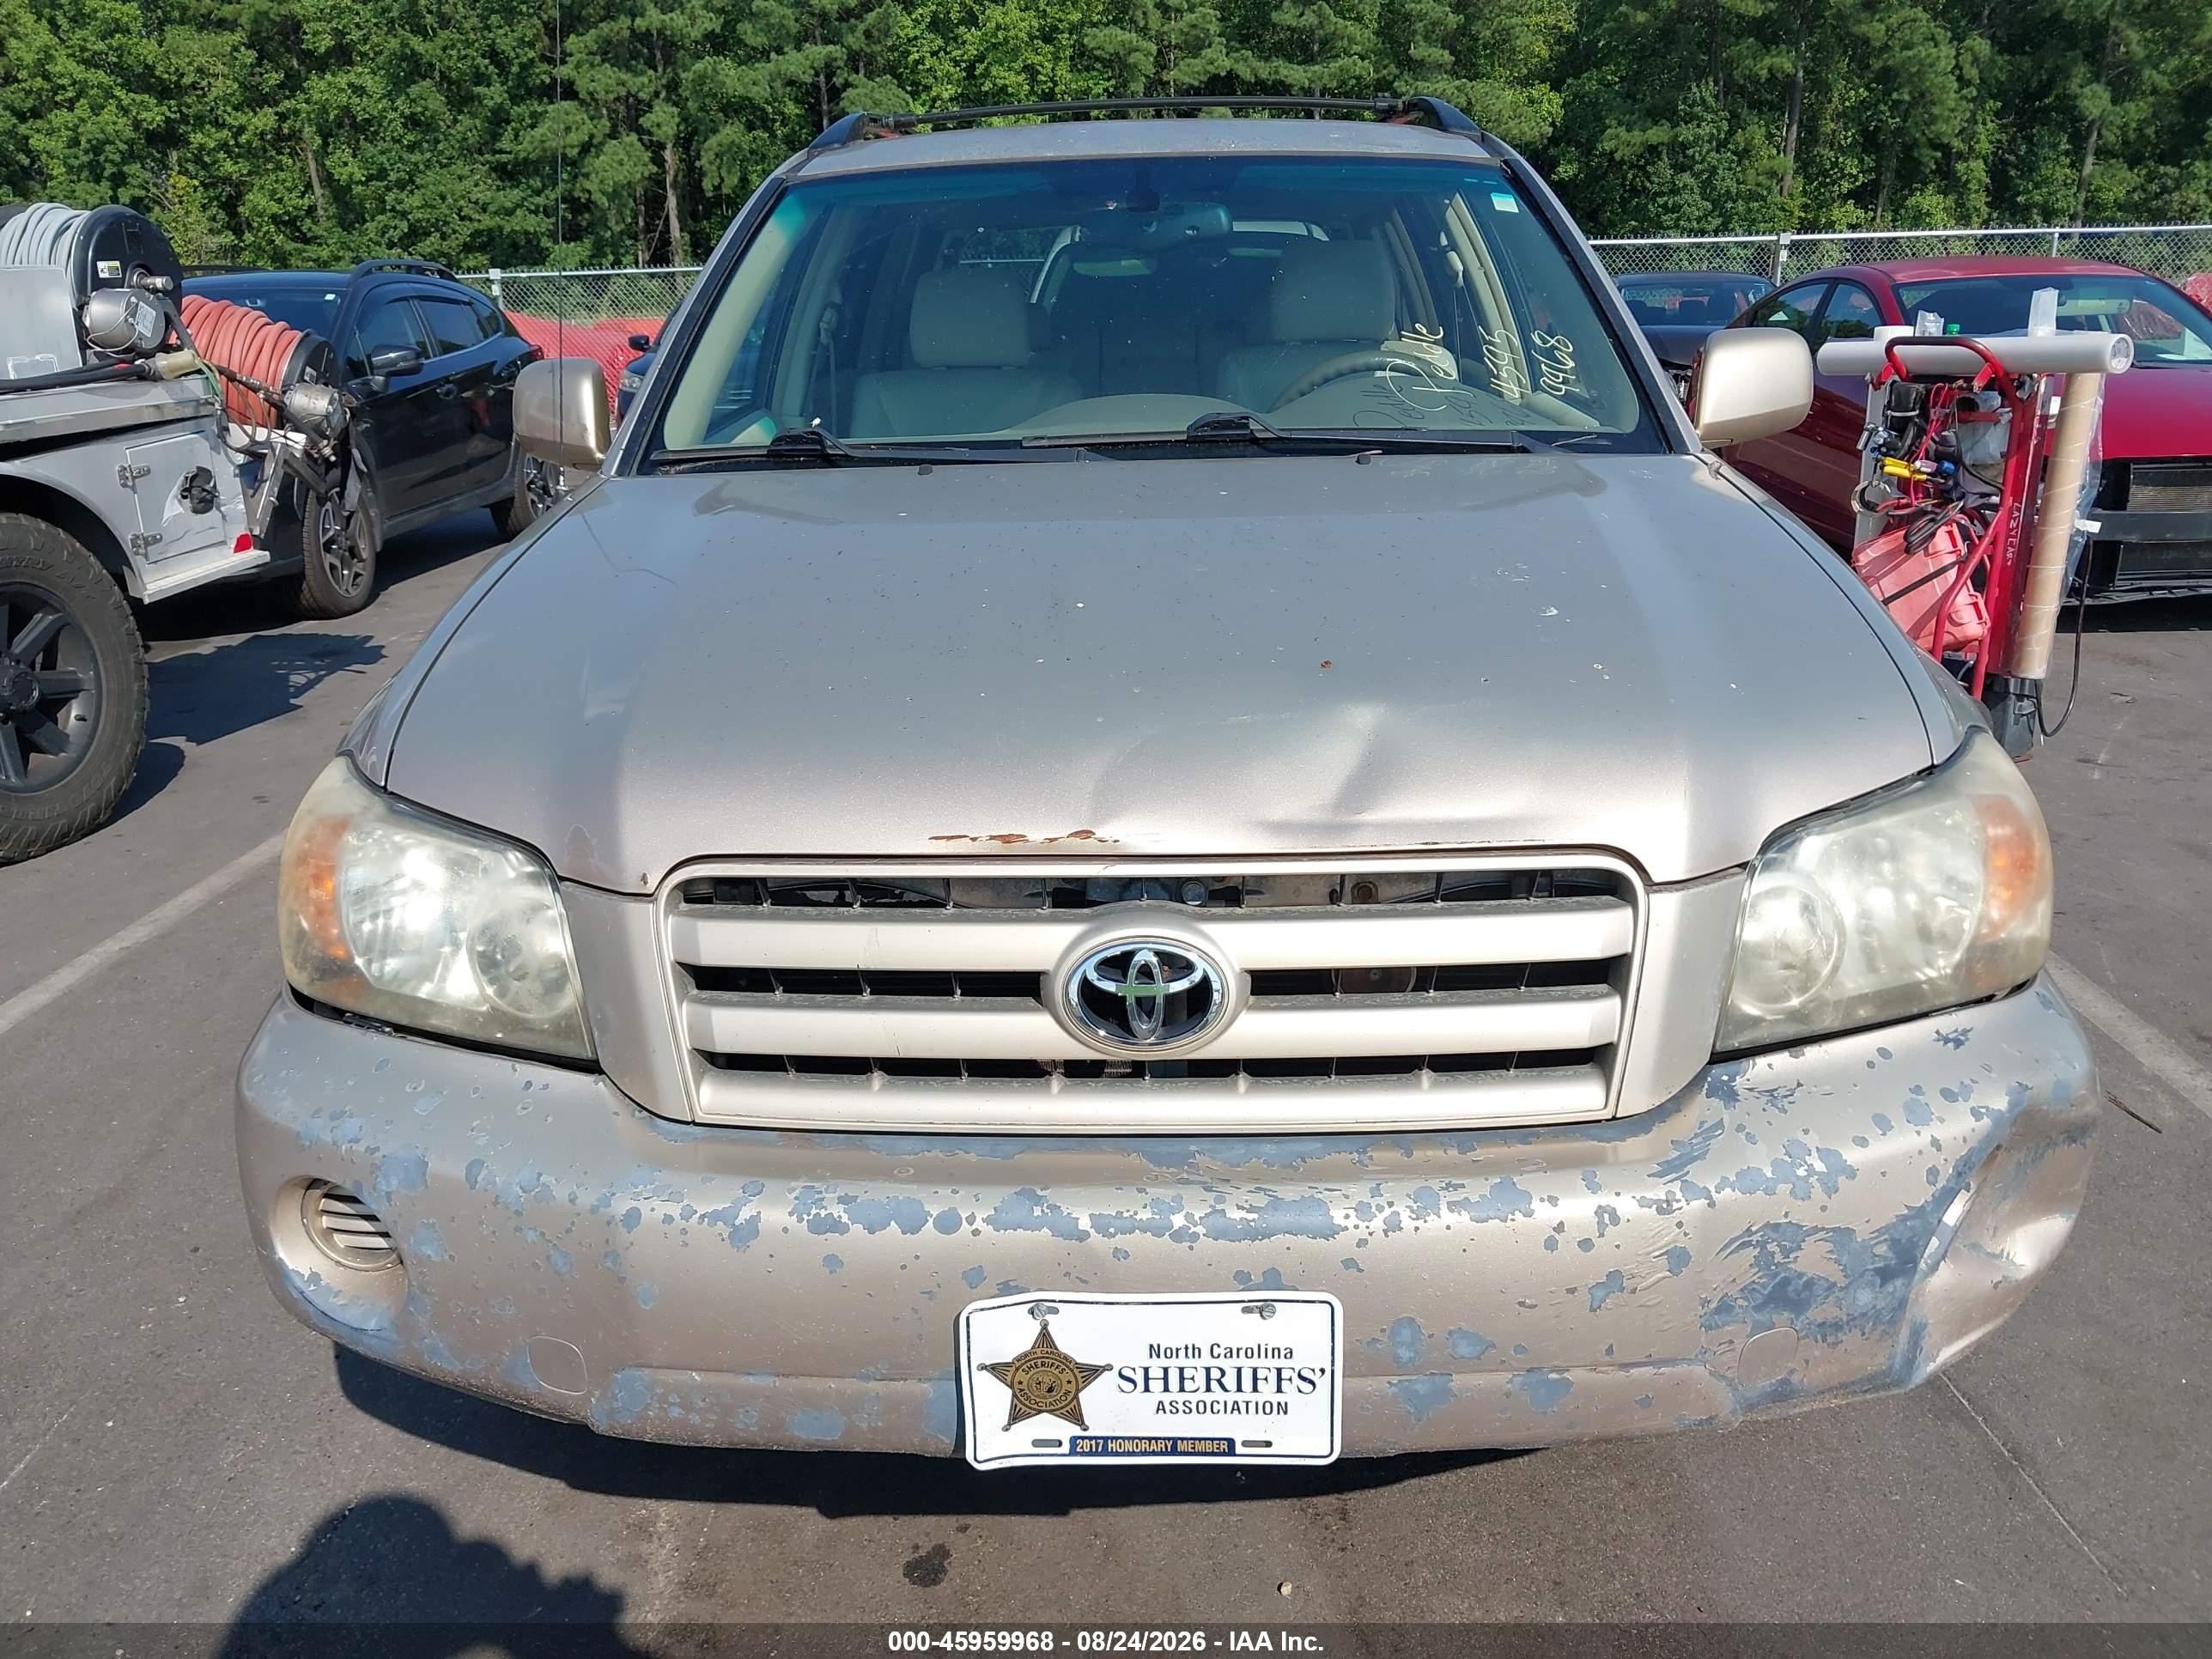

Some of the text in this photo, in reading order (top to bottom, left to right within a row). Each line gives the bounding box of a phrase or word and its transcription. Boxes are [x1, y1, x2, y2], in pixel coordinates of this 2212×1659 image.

[1478, 325, 1531, 399] 4595
[1530, 329, 1581, 396] 9968
[1016, 1349, 1073, 1364] NORTH CAROLINA
[1149, 1343, 1293, 1359] North Carolina
[1017, 1387, 1073, 1408] ASSOCIATION
[1155, 1400, 1289, 1415] ASSOCIATION
[1076, 1439, 1229, 1453] 2017 HONORARY MEMBER
